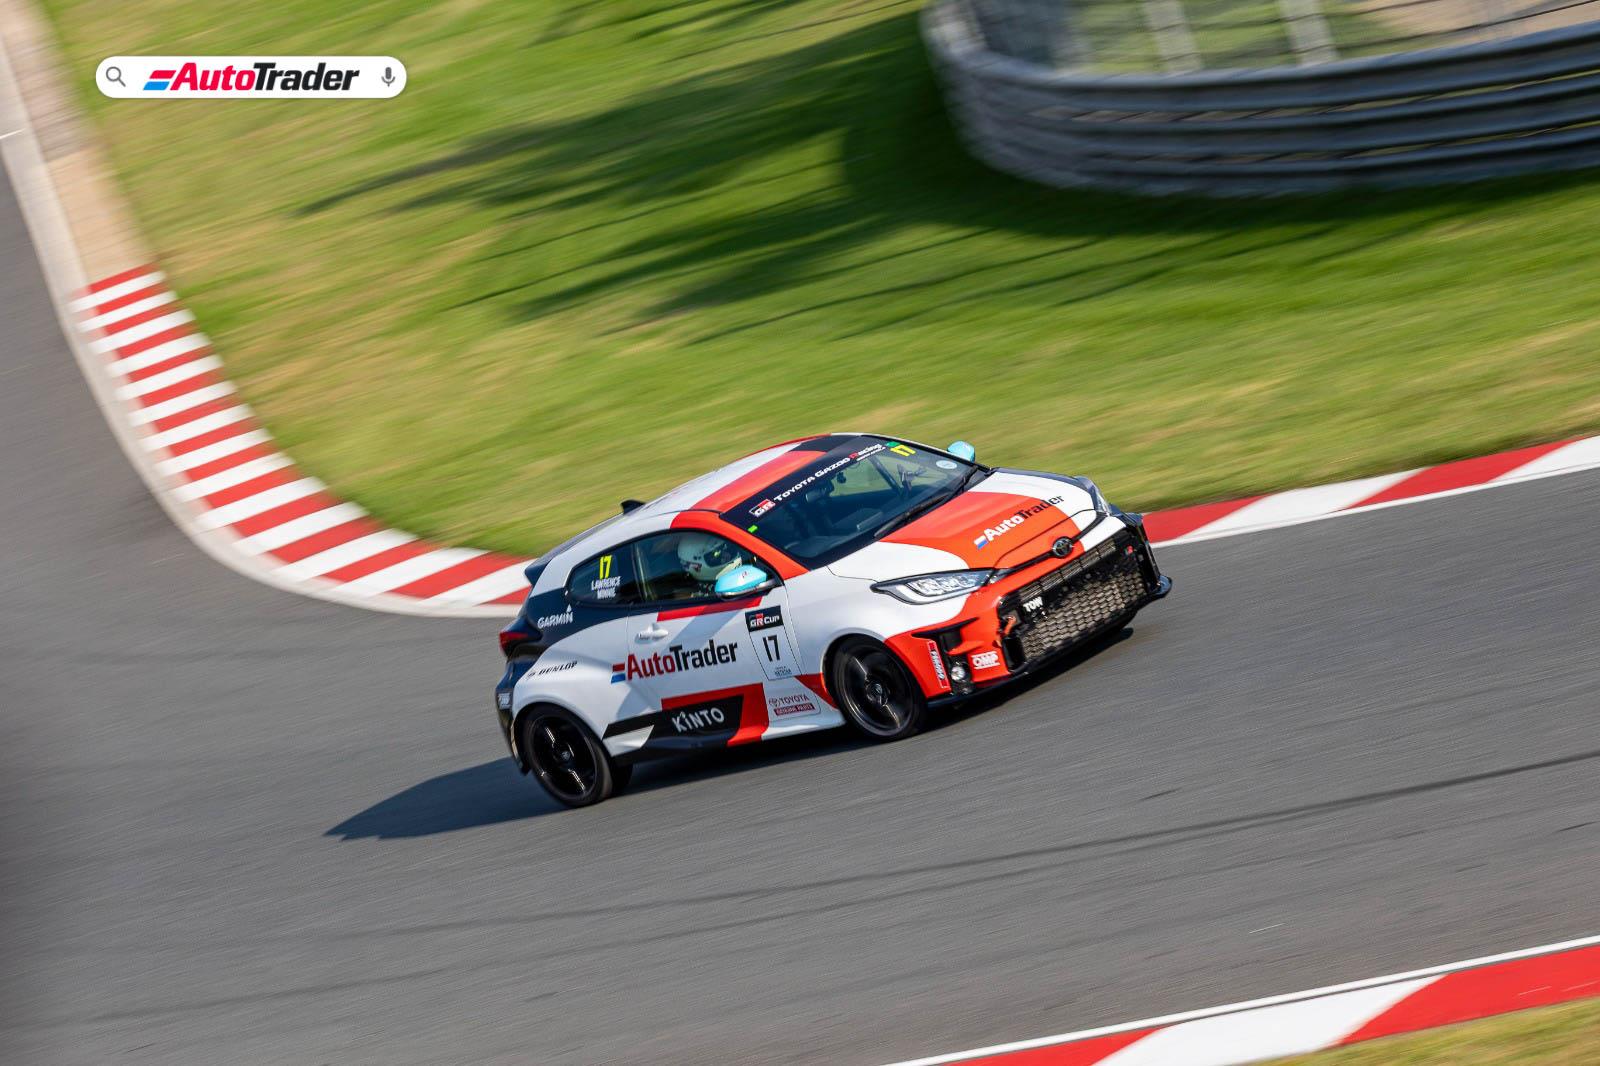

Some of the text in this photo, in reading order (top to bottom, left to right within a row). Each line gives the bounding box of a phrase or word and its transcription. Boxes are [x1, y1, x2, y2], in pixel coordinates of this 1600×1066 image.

[889, 444, 916, 457] 17
[773, 476, 816, 503] TOYOTA
[815, 457, 851, 478] GAZOO
[983, 495, 1065, 542] AutoTrader
[600, 555, 613, 579] 17
[1023, 596, 1043, 612] TOW
[537, 611, 574, 630] GARMIN
[762, 635, 781, 662] 17
[538, 660, 578, 676] DUNLOP
[627, 639, 738, 681] AutoTrader
[779, 693, 810, 705] TOYOTA
